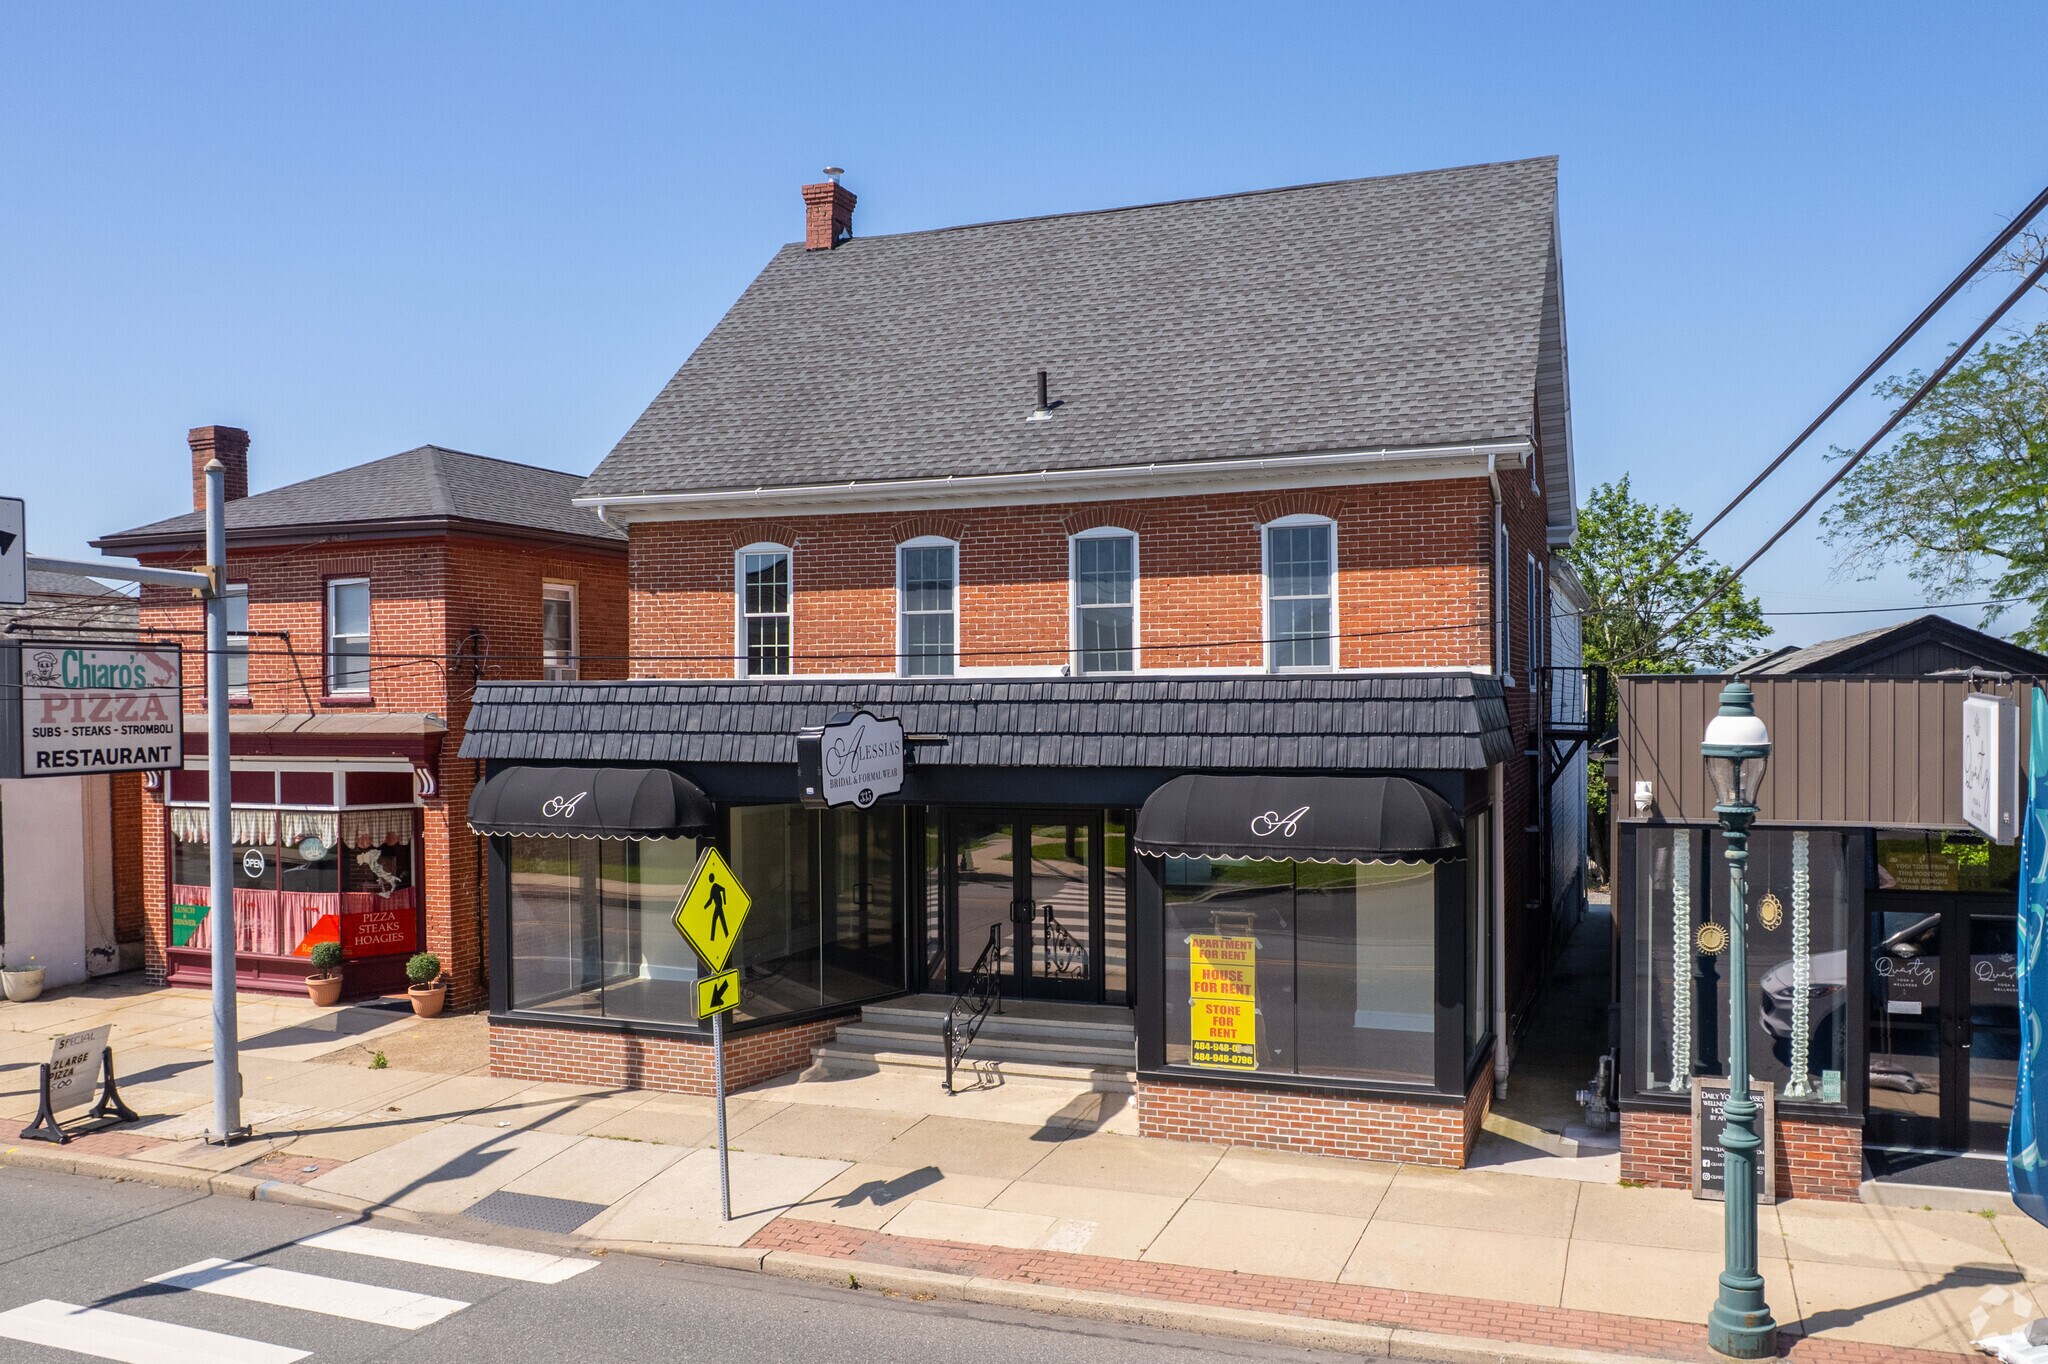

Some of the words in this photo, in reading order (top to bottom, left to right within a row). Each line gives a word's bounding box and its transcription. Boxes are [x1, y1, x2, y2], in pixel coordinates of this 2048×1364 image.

[62, 649, 146, 688] Chiaro's
[40, 693, 168, 724] PIZZA
[32, 727, 61, 738] SUBS
[72, 725, 111, 737] STEAKS
[121, 724, 173, 735] STROMBOLI
[37, 746, 171, 768] RESTAURANT
[829, 776, 852, 789] BRIDAL
[853, 776, 858, 784] &
[859, 771, 881, 783] FORMAL
[881, 768, 898, 779] WEAR
[542, 791, 587, 818] A
[1251, 806, 1310, 837] A
[244, 858, 264, 868] OPEN
[363, 912, 396, 923] PIZZA
[359, 922, 400, 934] STEAKS
[355, 932, 404, 945] HOAGIES
[1192, 938, 1253, 950] APARTMENT
[1199, 949, 1219, 959] FOR
[1221, 950, 1246, 960] RENT
[1202, 969, 1243, 982] HOUSE
[1194, 982, 1217, 993] FOR
[1221, 983, 1251, 995] RENT
[1205, 1004, 1240, 1016] STORE
[1212, 1016, 1233, 1027] FOR
[1209, 1028, 1237, 1039] RENT
[59, 1033, 95, 1049] SPECIAL
[1194, 1041, 1252, 1053] 484-948-0
[49, 1068, 74, 1080] PIZZA
